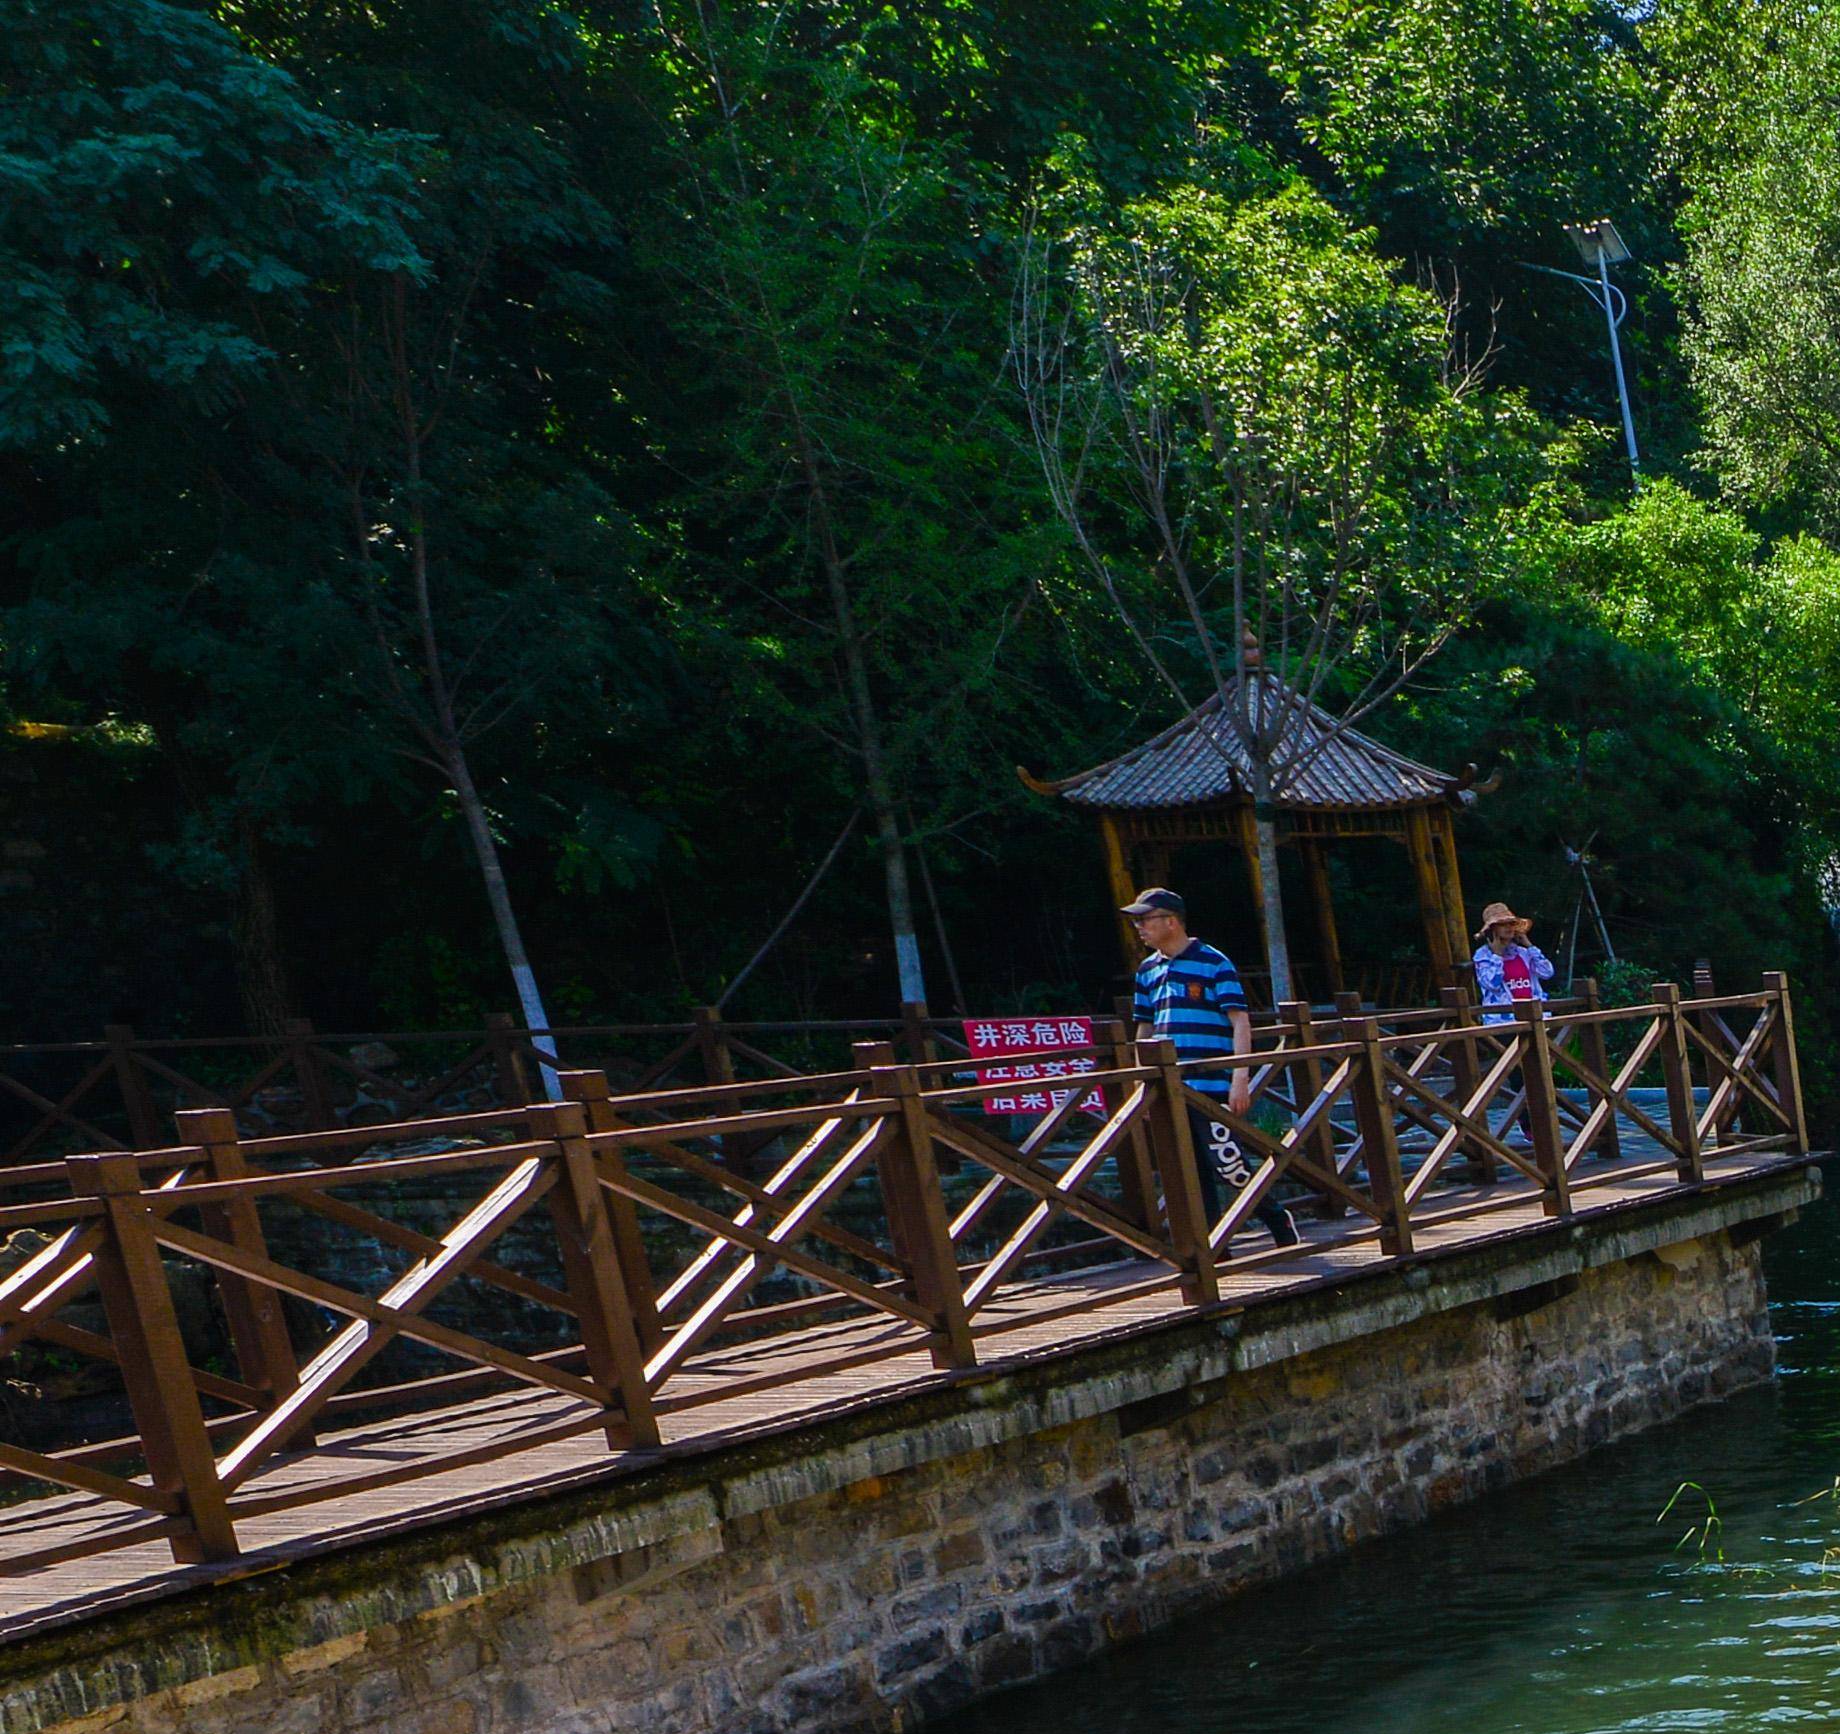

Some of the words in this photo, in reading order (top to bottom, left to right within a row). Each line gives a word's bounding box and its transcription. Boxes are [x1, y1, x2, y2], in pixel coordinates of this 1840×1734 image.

[1506, 978, 1531, 990] dida
[974, 1021, 1090, 1048] 井深危险
